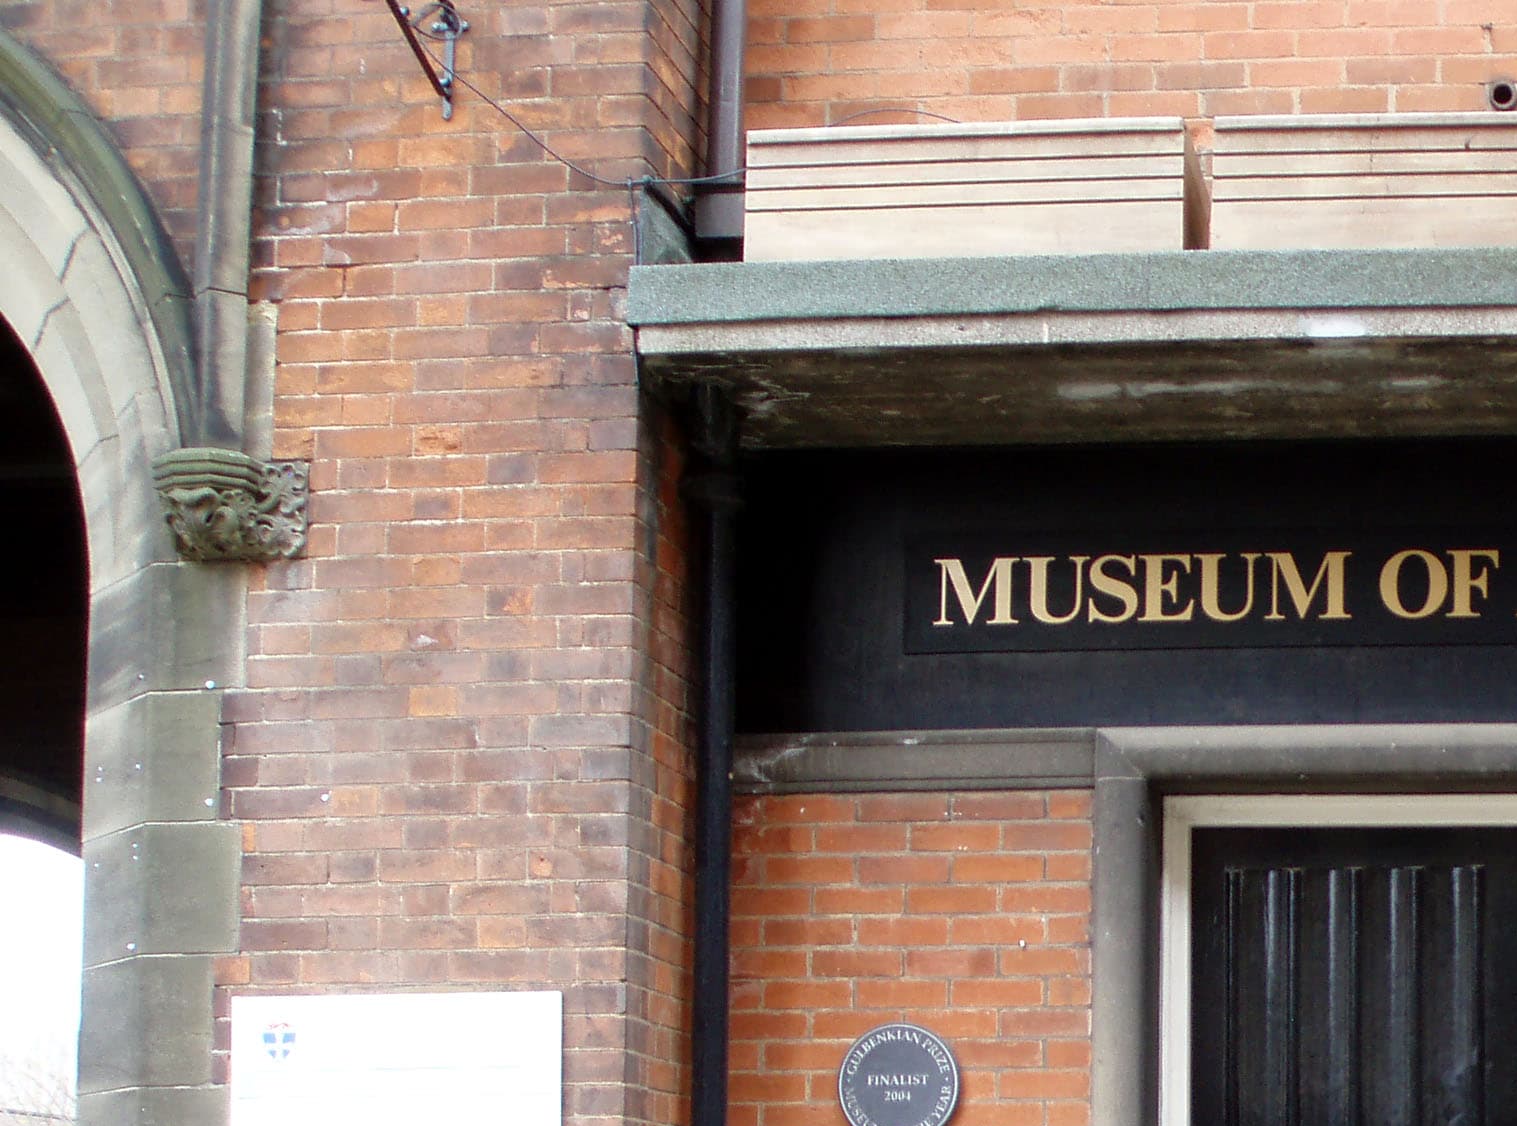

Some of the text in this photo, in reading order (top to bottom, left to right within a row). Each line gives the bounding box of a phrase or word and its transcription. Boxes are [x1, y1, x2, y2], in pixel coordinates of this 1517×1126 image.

[932, 551, 1352, 626] MUSEUM
[1379, 548, 1500, 619] OF
[846, 1030, 950, 1076] GULBENKIAN PRIZE
[867, 1073, 929, 1087] FINALIST
[884, 1091, 911, 1102] 2004
[930, 1085, 952, 1120] YEAR
